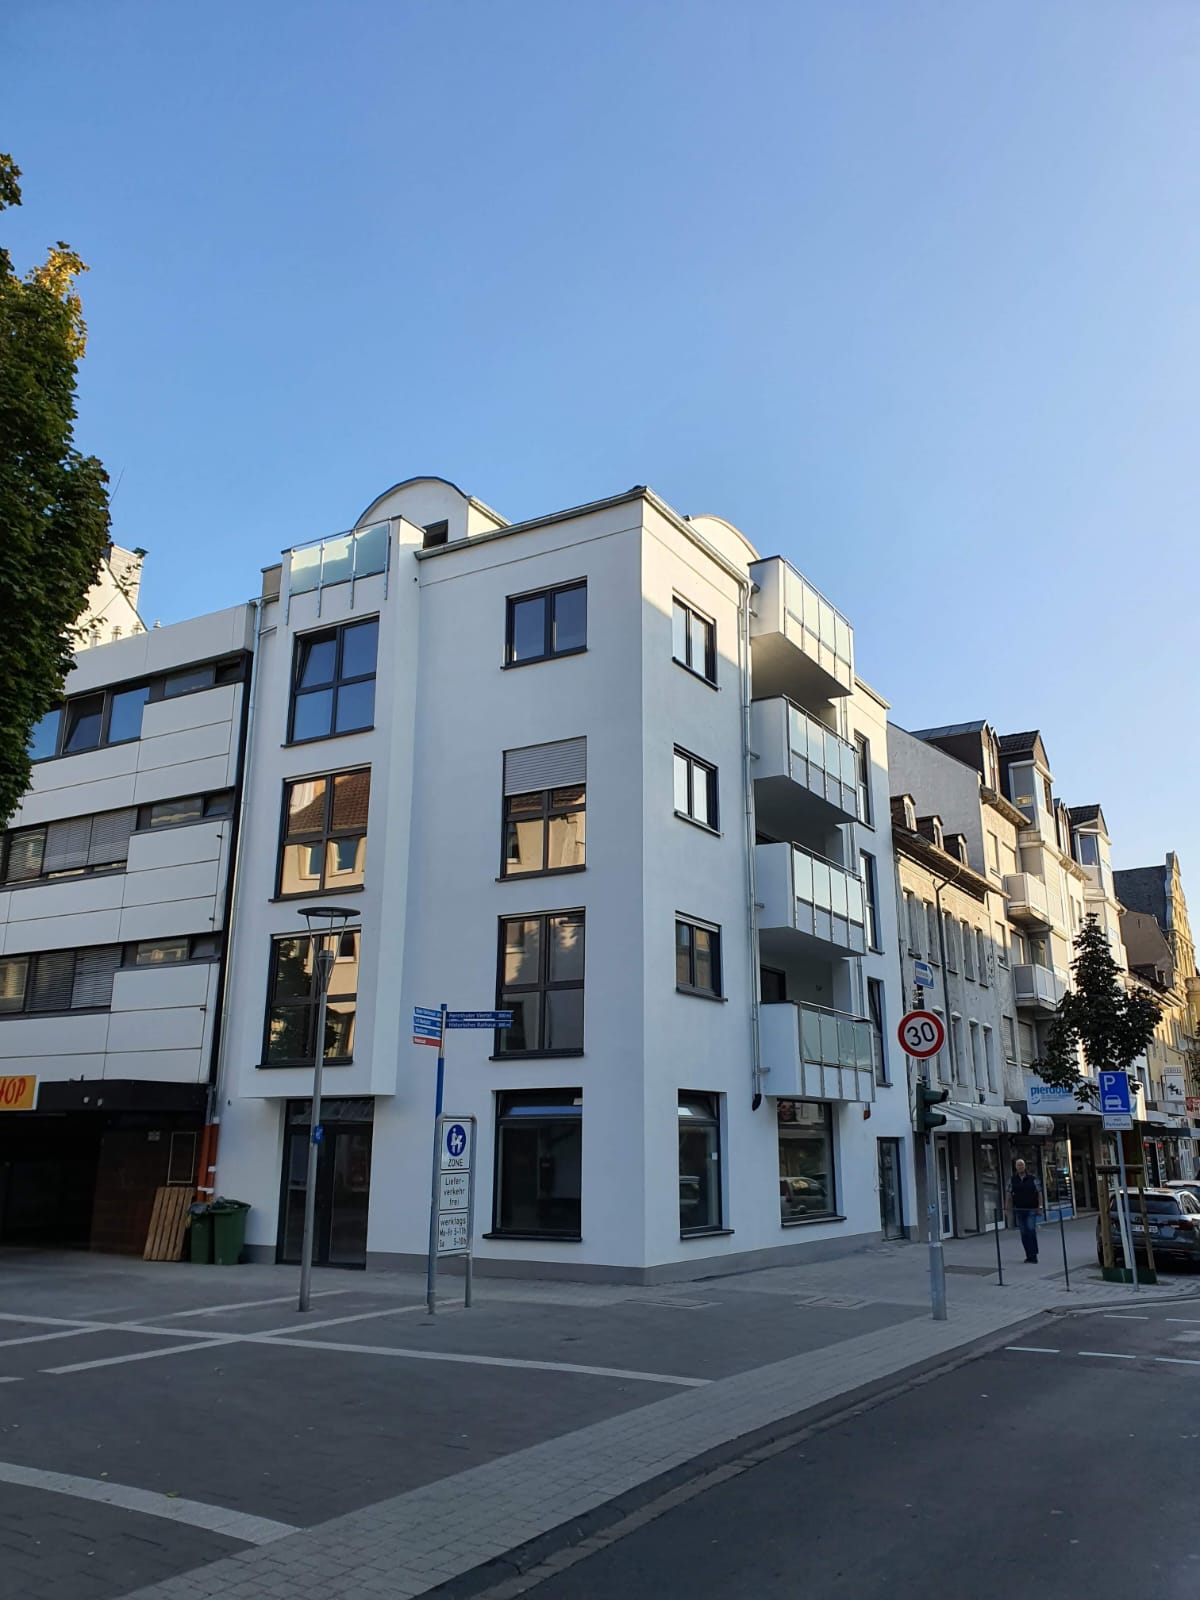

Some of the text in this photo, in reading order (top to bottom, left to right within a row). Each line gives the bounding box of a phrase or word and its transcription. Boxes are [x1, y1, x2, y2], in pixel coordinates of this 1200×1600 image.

[906, 1021, 935, 1047] 30
[1103, 1075, 1116, 1091] P
[447, 1158, 464, 1168] ZONE
[445, 1176, 465, 1186] Liefer-
[443, 1187, 465, 1196] verkehr
[449, 1198, 460, 1206] frei
[440, 1217, 466, 1227] werktags
